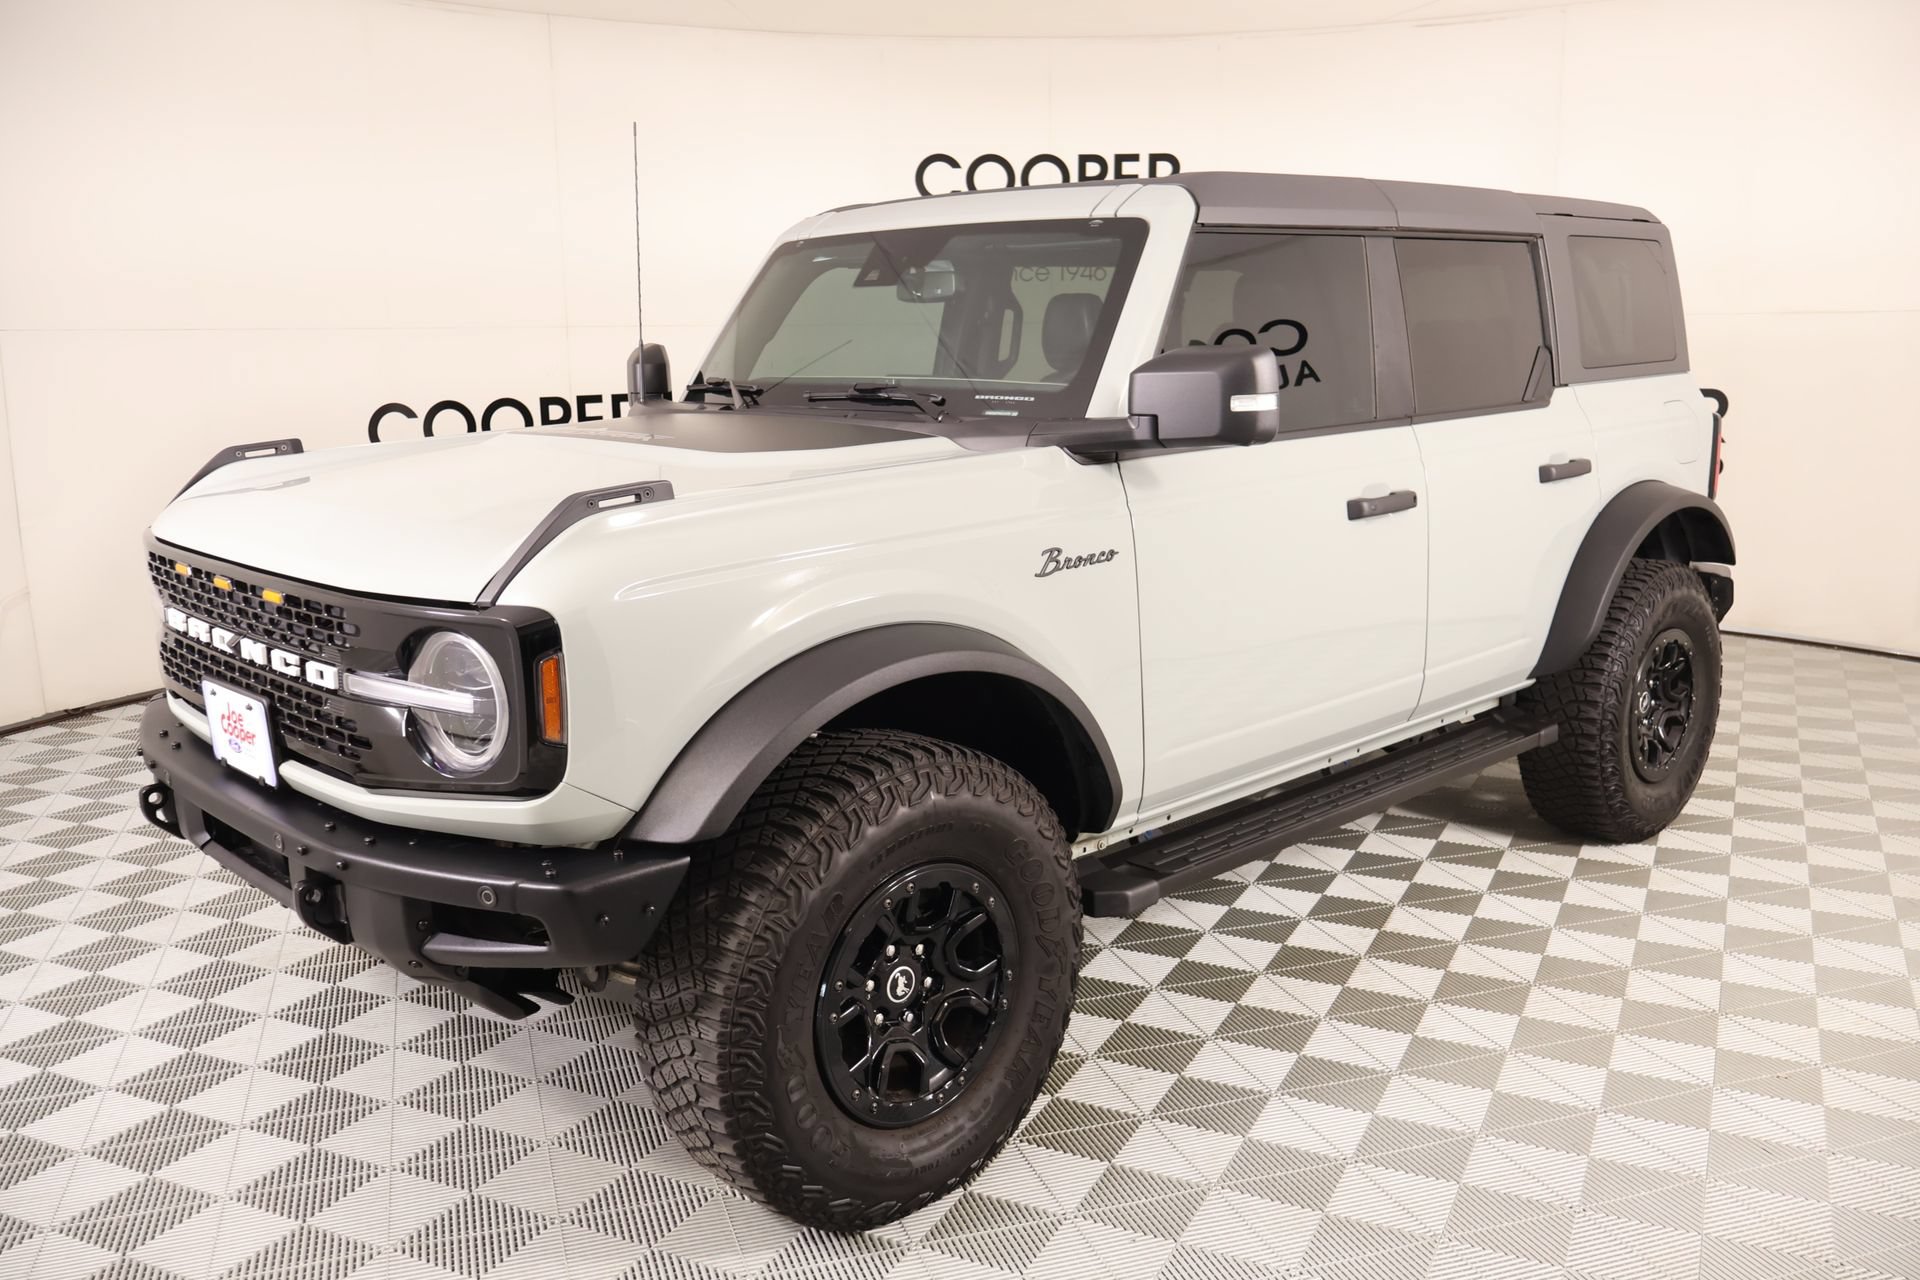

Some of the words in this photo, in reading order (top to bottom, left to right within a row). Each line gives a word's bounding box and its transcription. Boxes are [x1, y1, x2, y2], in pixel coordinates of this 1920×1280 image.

[368, 393, 630, 443] COOPE
[1034, 546, 1120, 578] Bronco
[164, 606, 340, 690] BRONCO
